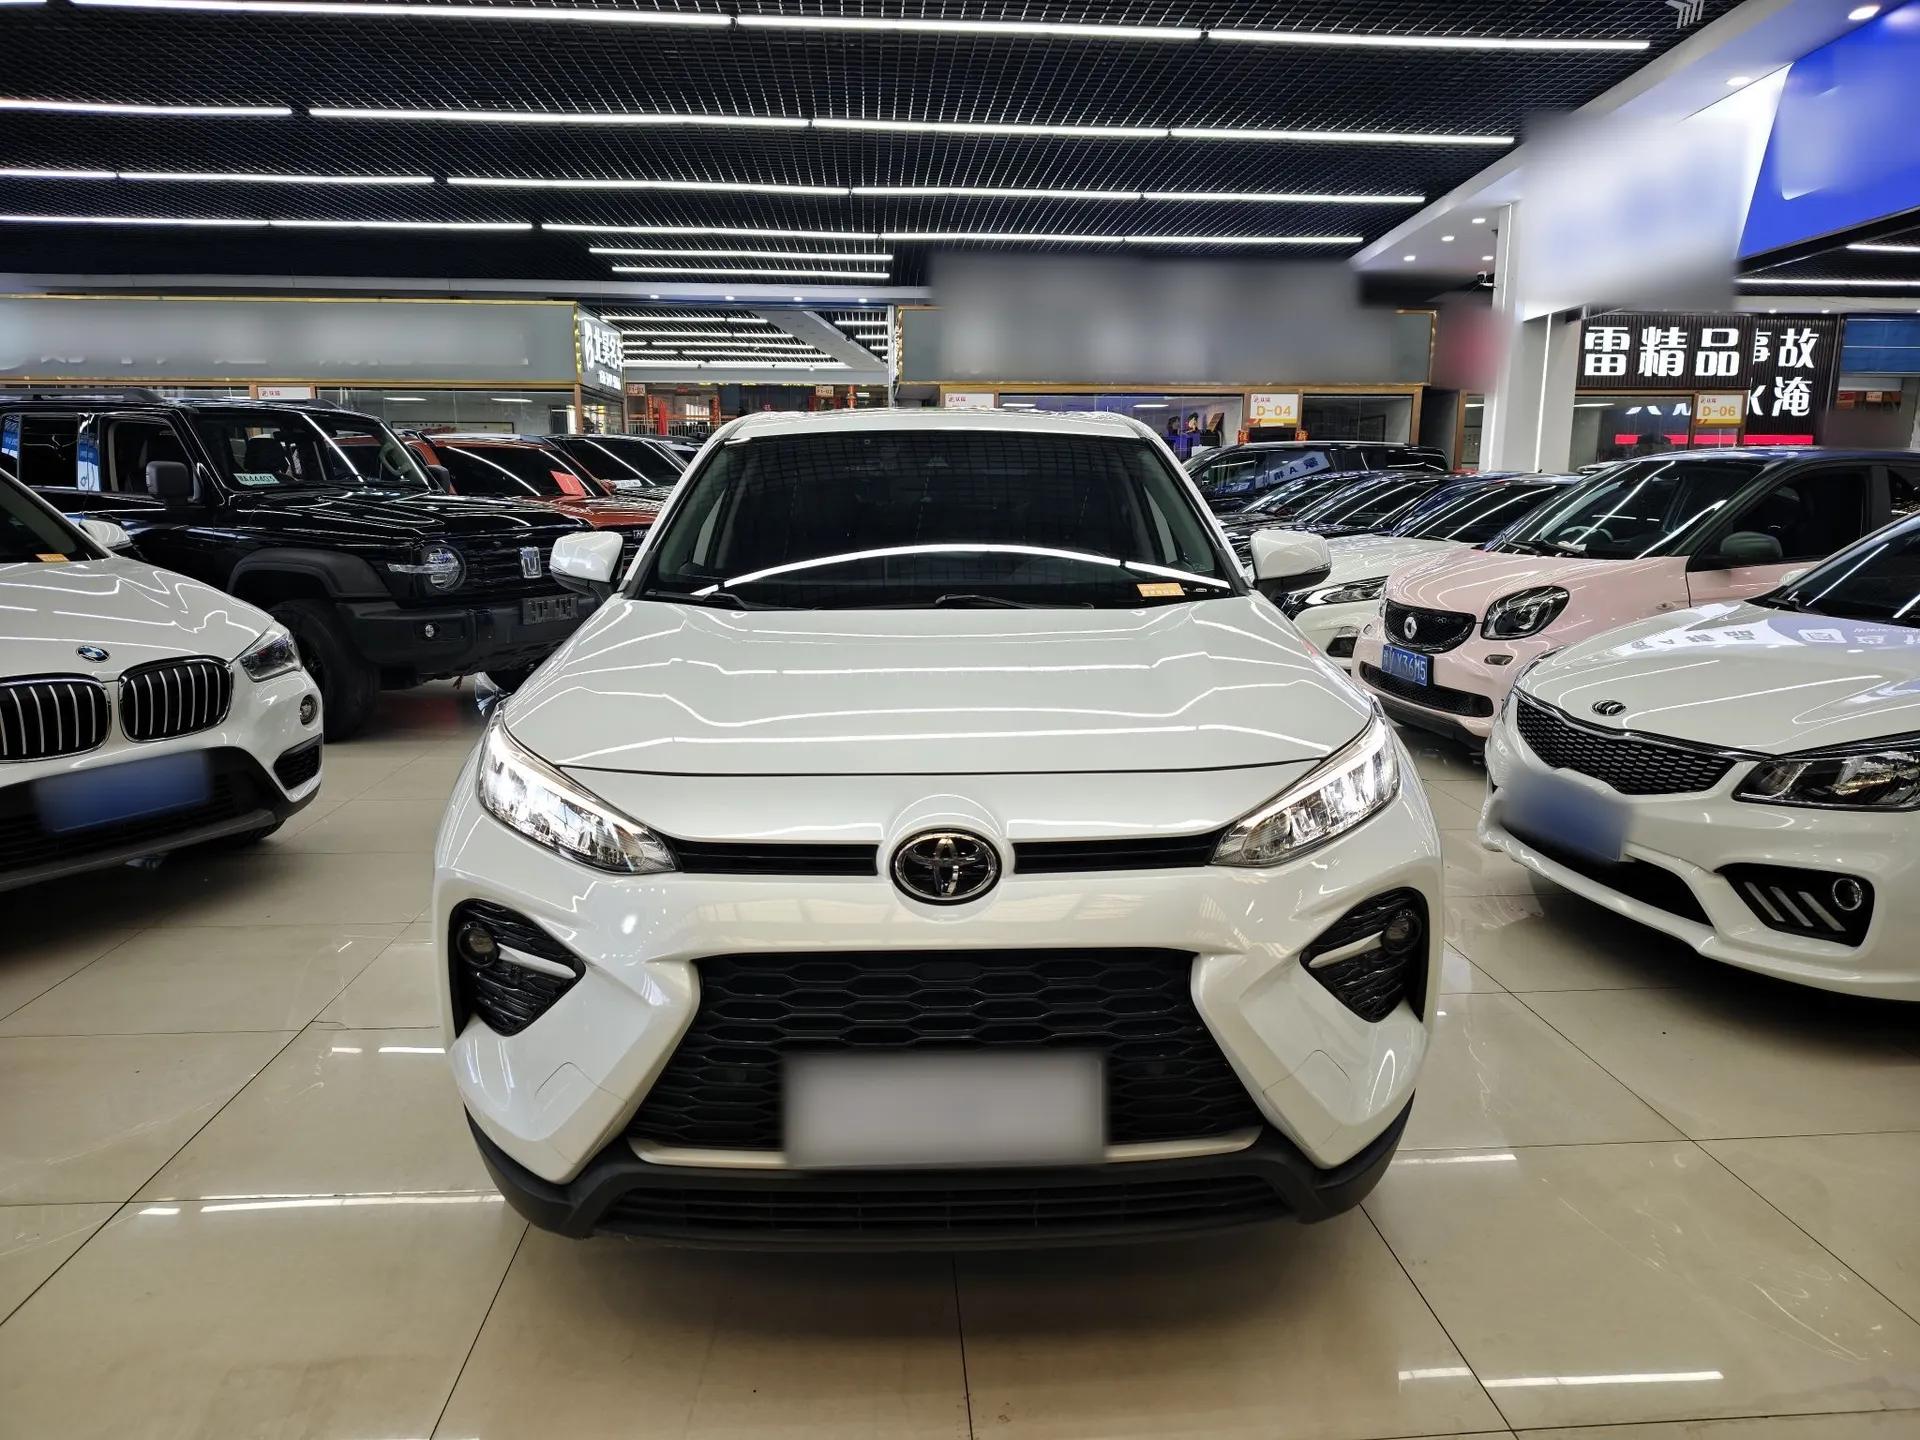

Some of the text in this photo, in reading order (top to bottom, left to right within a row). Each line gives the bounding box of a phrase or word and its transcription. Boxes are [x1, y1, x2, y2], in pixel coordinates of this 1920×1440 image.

[1584, 327, 1740, 377] 雷精品
[1257, 406, 1291, 416] D-04
[1703, 406, 1736, 416] D-06
